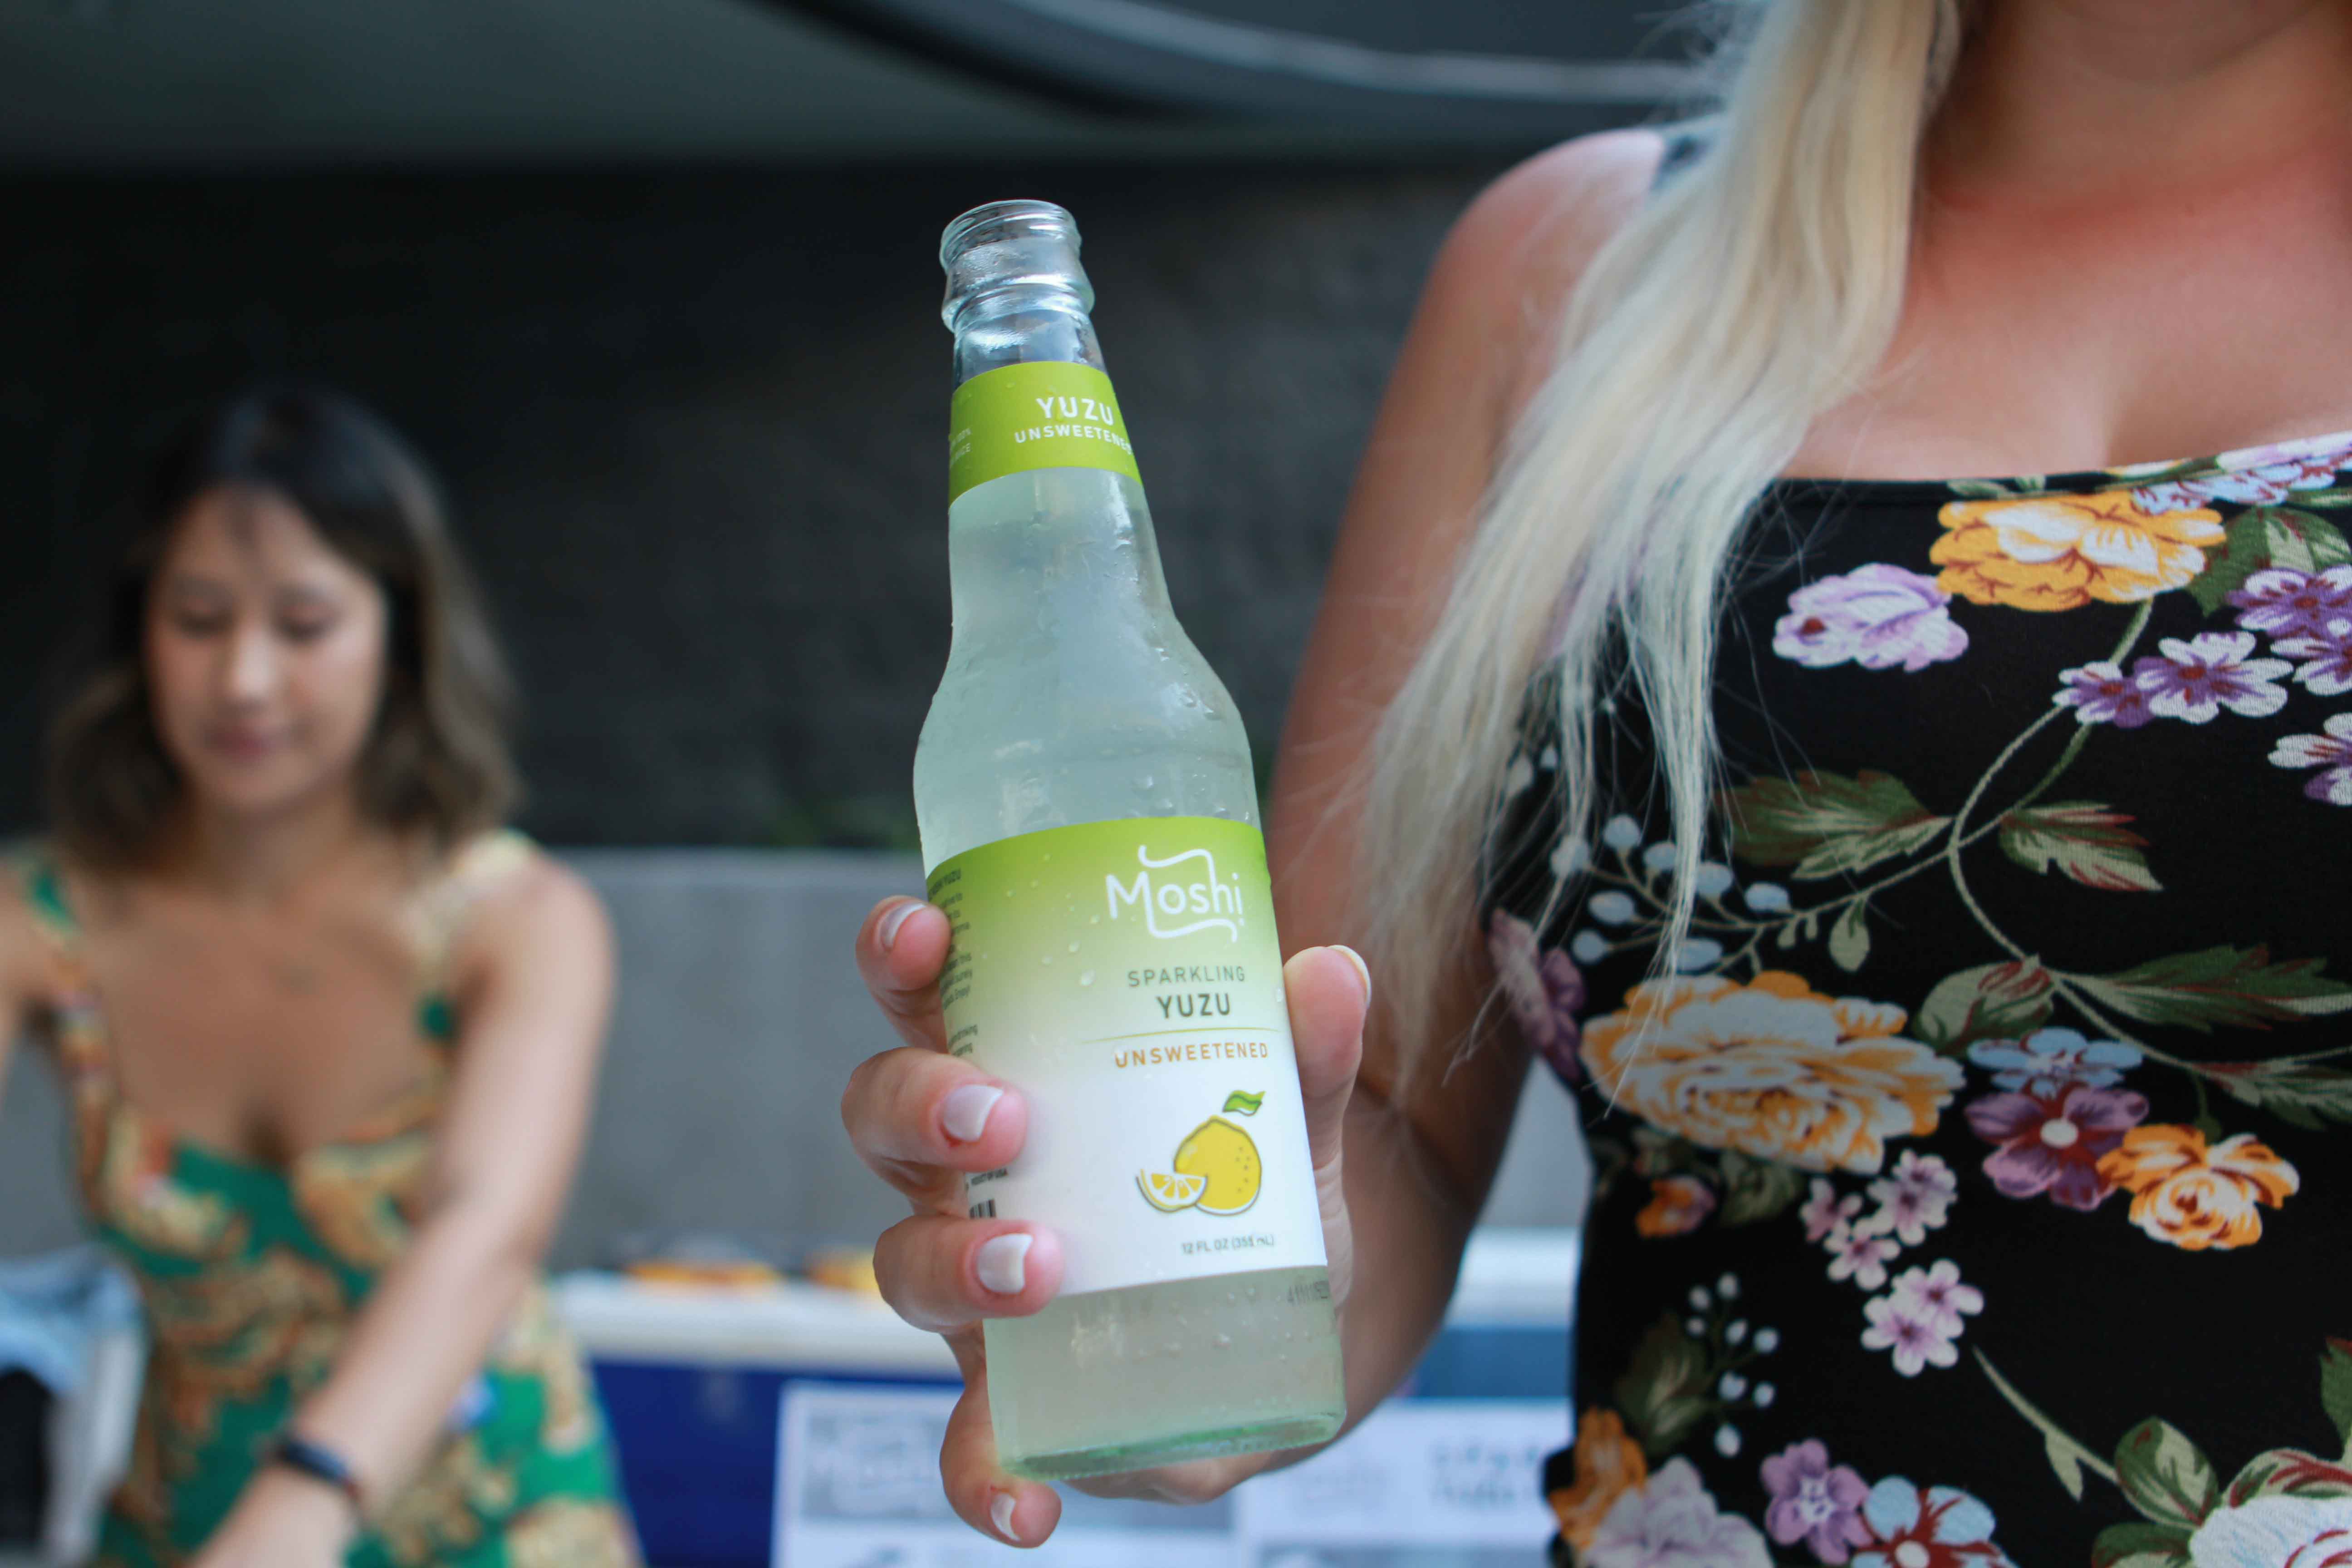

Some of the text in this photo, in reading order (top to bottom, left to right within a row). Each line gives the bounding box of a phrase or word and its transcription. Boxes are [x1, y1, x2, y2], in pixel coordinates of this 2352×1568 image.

[1036, 396, 1114, 426] YUZU
[1014, 424, 1133, 455] UNSWEETENED
[1105, 844, 1245, 943] Moshi
[1128, 965, 1246, 988] SPARKLING
[1156, 992, 1231, 1019] YUZU
[1114, 1042, 1269, 1069] UNSWEETENED
[1181, 1241, 1193, 1254] 12
[1196, 1240, 1212, 1253] FL
[1214, 1237, 1229, 1250] OZ
